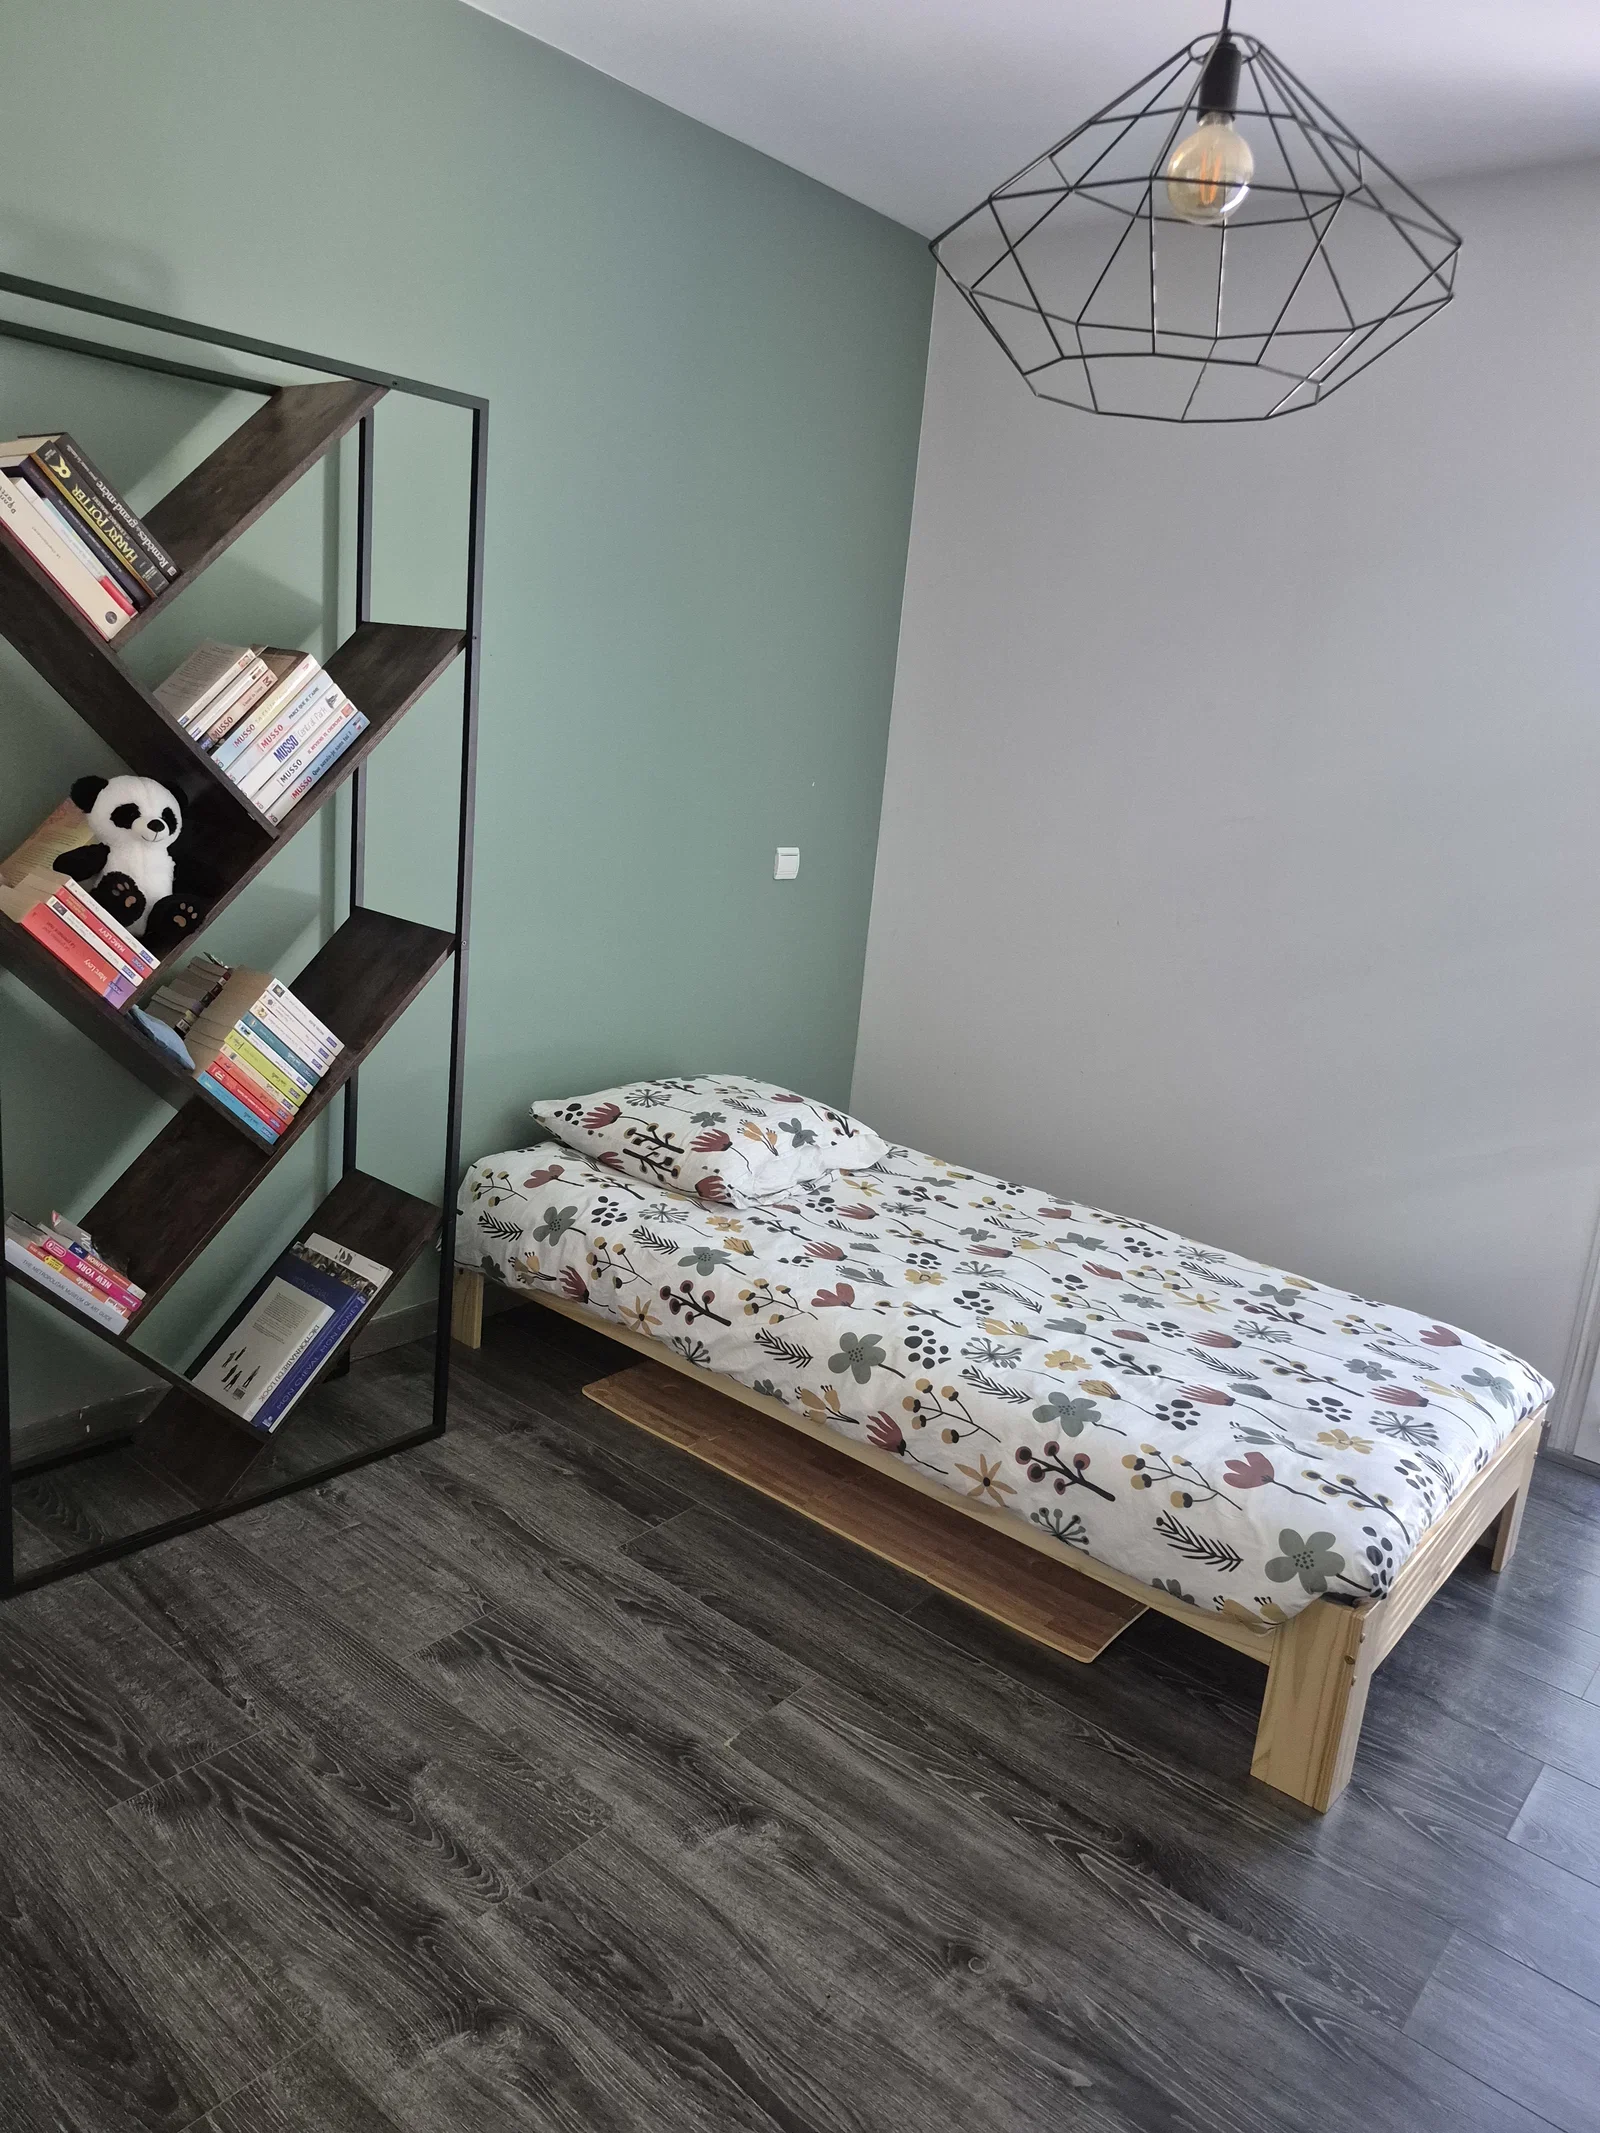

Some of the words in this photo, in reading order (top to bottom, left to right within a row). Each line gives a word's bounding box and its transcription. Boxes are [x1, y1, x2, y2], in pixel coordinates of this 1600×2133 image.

[0, 485, 16, 505] Tart
[0, 494, 16, 514] Donn
[71, 483, 109, 526] POTTER
[93, 479, 138, 529] grand-mère
[103, 528, 138, 563] HARRY
[135, 530, 169, 568] Remèdes
[210, 715, 233, 739] MUSSO
[233, 723, 256, 747] MUSSO
[260, 723, 284, 748] MUSSO
[272, 734, 300, 762] MUSSO
[297, 717, 316, 738] Central
[313, 705, 327, 720] Park
[279, 758, 303, 783] MUSSO
[290, 775, 313, 799] MUSSO
[311, 765, 321, 776] Que
[97, 926, 112, 940] LEVY
[110, 938, 125, 952] MARC
[82, 957, 97, 971] Levy
[93, 968, 107, 981] Marc
[75, 1261, 96, 1277] YORK
[85, 1254, 108, 1272] RÉUNION
[22, 1259, 32, 1268] THE
[31, 1265, 65, 1290] METROPOLITAN
[64, 1287, 84, 1303] MUSEUM
[98, 1310, 112, 1321] GUIDE
[74, 1276, 94, 1292] Suède
[94, 1274, 112, 1289] NEW
[276, 1387, 295, 1410] MON
[319, 1331, 338, 1353] MON
[336, 1302, 359, 1330] PONEY
[281, 1323, 320, 1372] DICTIONNAIRE
[273, 1370, 284, 1382] DU
[257, 1380, 276, 1402] LOOK
